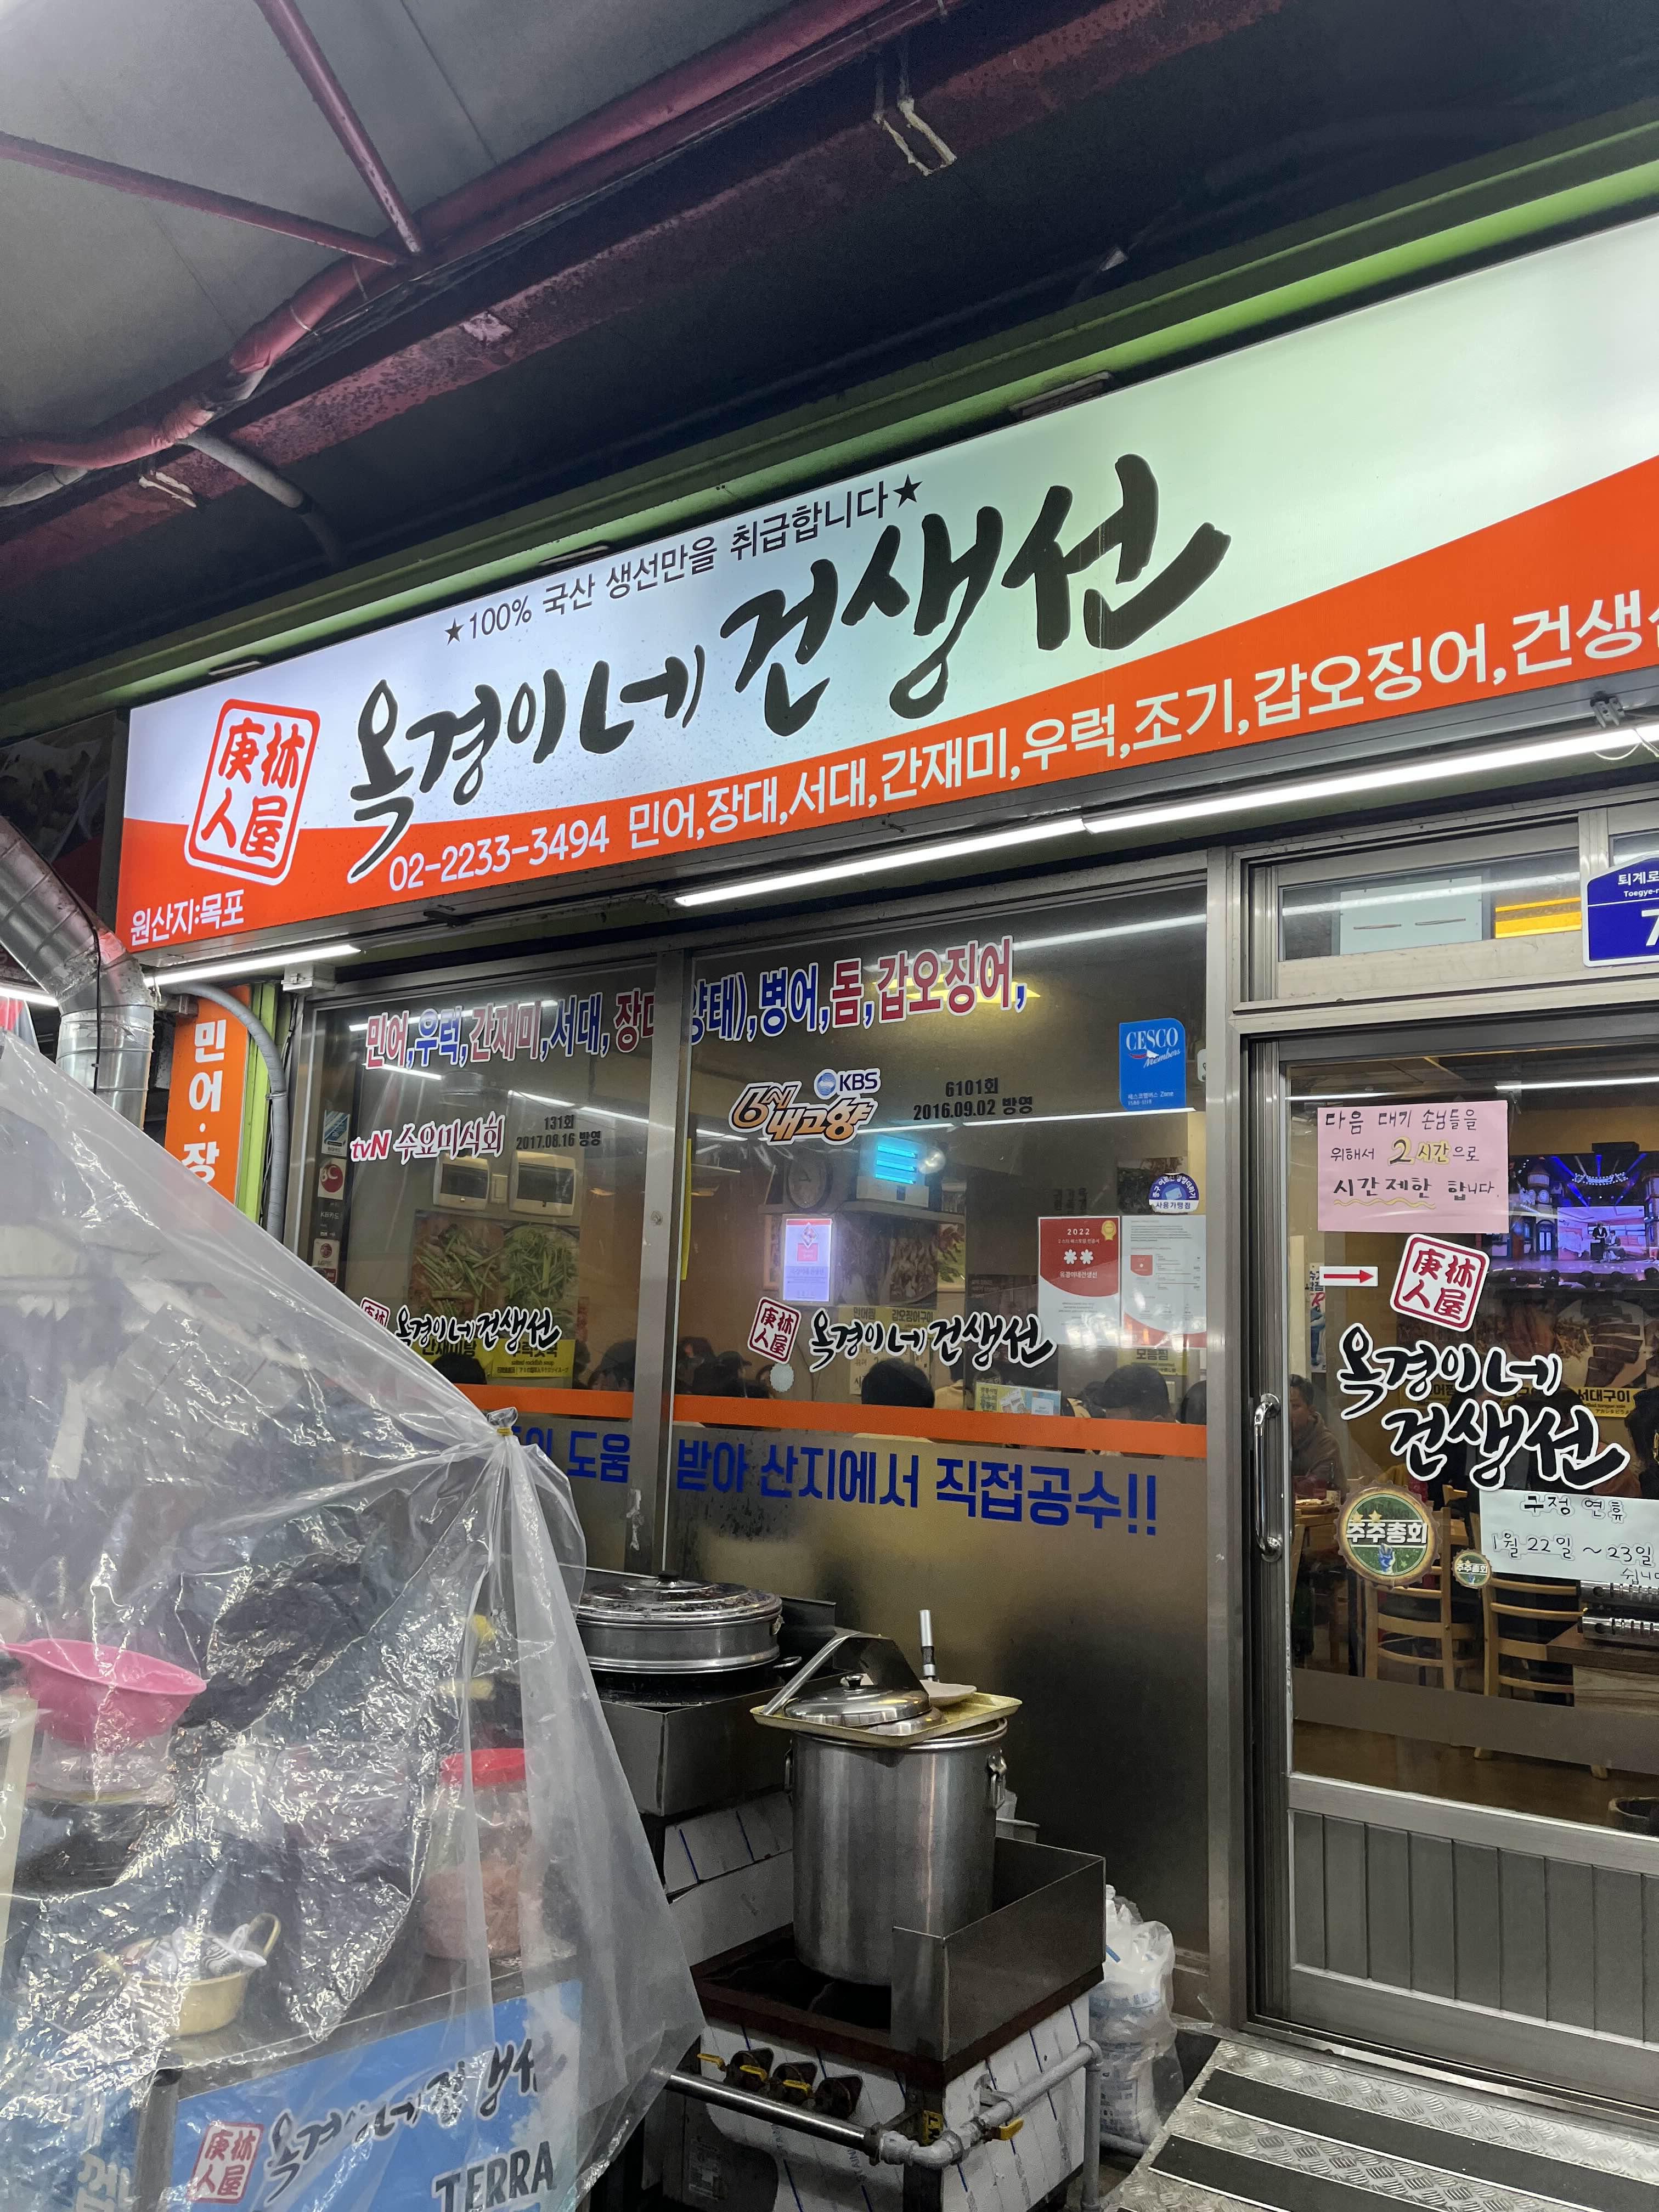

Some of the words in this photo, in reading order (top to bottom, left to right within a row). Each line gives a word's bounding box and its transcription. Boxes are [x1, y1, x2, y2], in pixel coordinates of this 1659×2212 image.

[467, 595, 533, 640] 100%
[542, 573, 595, 616] 국산
[605, 535, 718, 600] 생선만을
[729, 475, 889, 562] 취급합니다
[349, 644, 707, 880] 옥경이네
[719, 453, 1232, 737] 건생선
[388, 815, 611, 892] 02-2233-3494
[130, 888, 245, 947] 원산지:목포
[1126, 1027, 1179, 1051] CESCO
[1142, 1047, 1181, 1069] Members
[838, 1070, 880, 1092] KBS
[945, 1077, 999, 1098] 6101회
[544, 1114, 575, 1131] 131회
[730, 1082, 802, 1132] 6시
[767, 1098, 878, 1144] 내고향
[913, 1099, 996, 1121] 2016.09.02
[1001, 1096, 1034, 1116] 방영
[1324, 1110, 1364, 1135] 다음
[1378, 1109, 1413, 1128] 대기
[1421, 1108, 1479, 1131] 손님들을
[350, 1130, 392, 1162] tvN
[393, 1112, 506, 1165] 수요미식회
[516, 1132, 575, 1150] 2017.08.16
[578, 1131, 602, 1147] 방영
[1330, 1147, 1375, 1161] 위해서
[1066, 1228, 1091, 1236] 2022
[476, 1306, 562, 1355] 건생선
[809, 1308, 928, 1373] 옥경이네
[928, 1311, 1058, 1372] 건생선
[1337, 1322, 1563, 1421] 옥경이네
[566, 1429, 631, 1485] 도움
[1381, 1399, 1631, 1491] 건생선
[676, 1438, 747, 1494] 받아
[760, 1446, 920, 1509] 산지에서
[935, 1457, 1158, 1536] 직접공수!!
[1524, 1495, 1571, 1516] 구정
[1584, 1498, 1625, 1522] 연휴
[1345, 1521, 1427, 1545] 주주총회
[1456, 1562, 1488, 1574] 주주총회
[435, 2141, 555, 2212] TERRA
